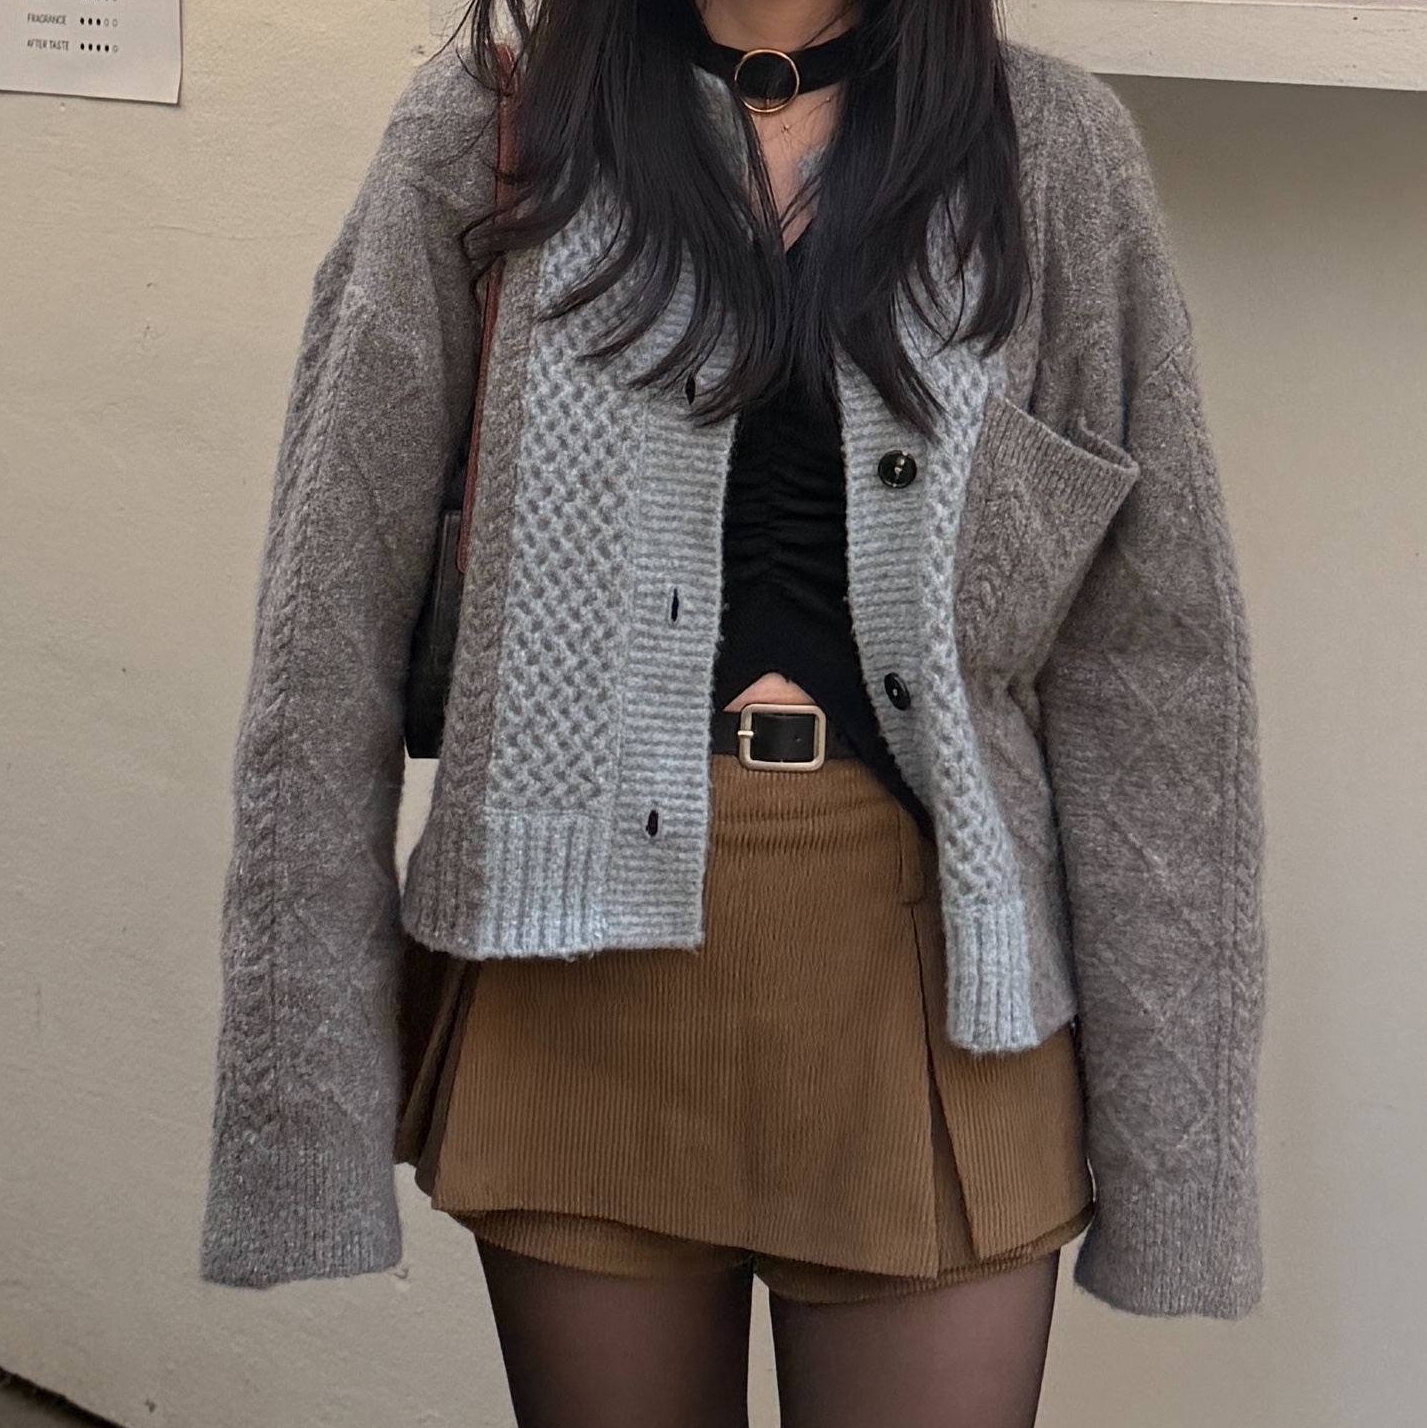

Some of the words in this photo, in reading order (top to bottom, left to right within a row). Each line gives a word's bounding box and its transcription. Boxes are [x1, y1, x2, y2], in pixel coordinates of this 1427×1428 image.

[27, 12, 68, 26] FRAGRANCE
[26, 38, 48, 50] AFTER
[48, 39, 70, 52] TASTE
